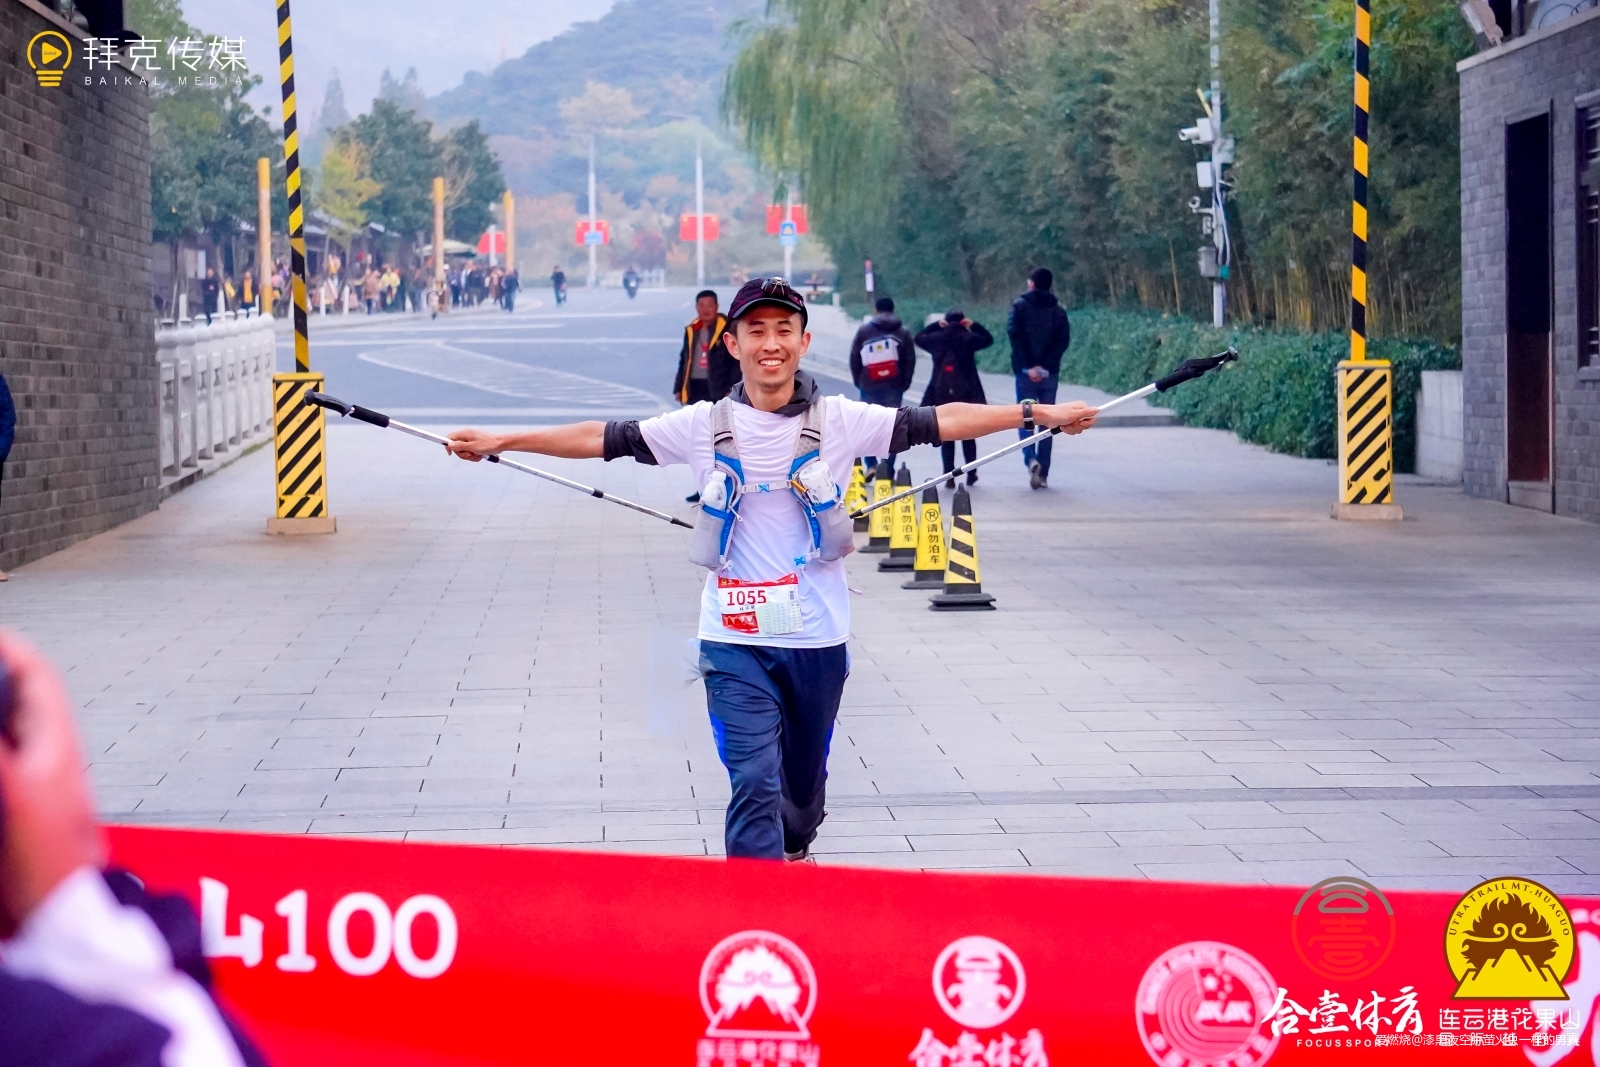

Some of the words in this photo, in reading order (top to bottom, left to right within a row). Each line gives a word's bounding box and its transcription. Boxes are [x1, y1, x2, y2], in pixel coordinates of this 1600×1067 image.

[900, 504, 914, 543] 请勿泊车
[926, 523, 941, 565] 请勿泊车
[726, 589, 768, 607] 1055
[199, 876, 458, 979] 4100
